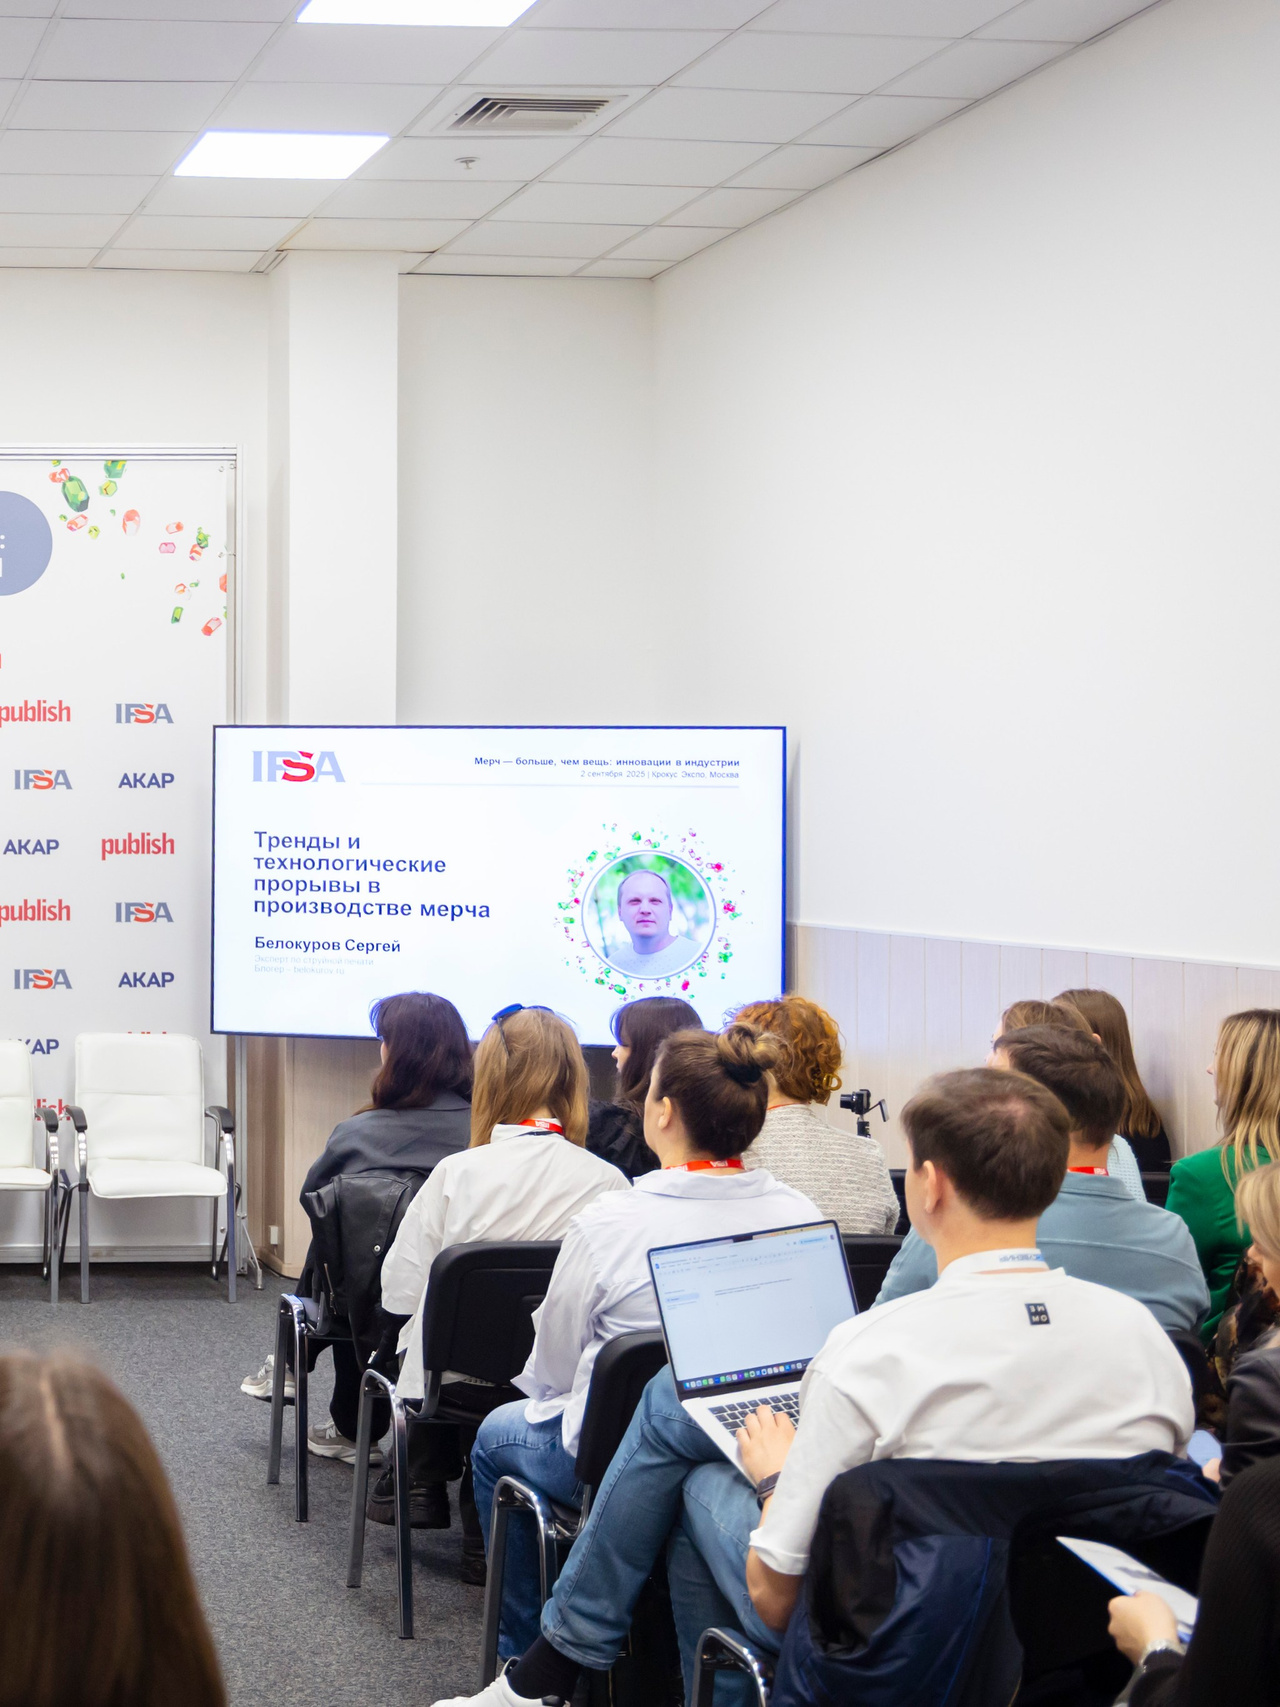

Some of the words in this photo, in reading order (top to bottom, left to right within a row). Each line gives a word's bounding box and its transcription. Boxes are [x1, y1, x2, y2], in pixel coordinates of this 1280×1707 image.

[474, 757, 501, 767] Мерч
[515, 756, 557, 766] больше,
[582, 759, 612, 767] вещь:
[616, 759, 672, 767] инновации
[675, 759, 682, 767] в
[684, 759, 740, 769] индустрии
[580, 769, 586, 778] 2
[587, 770, 623, 779] сентября
[626, 770, 646, 778] 2025
[651, 771, 678, 779] Крокус
[709, 771, 740, 779] Москва
[101, 831, 175, 861] publish
[253, 830, 340, 853] Тренды
[348, 836, 360, 850] и
[253, 857, 446, 873] технологические
[254, 878, 361, 897] прорывы
[368, 880, 381, 894] в
[254, 900, 412, 918] производстве
[420, 903, 490, 922] мерча
[255, 936, 341, 953] Белокуров
[344, 938, 401, 955] Сергей
